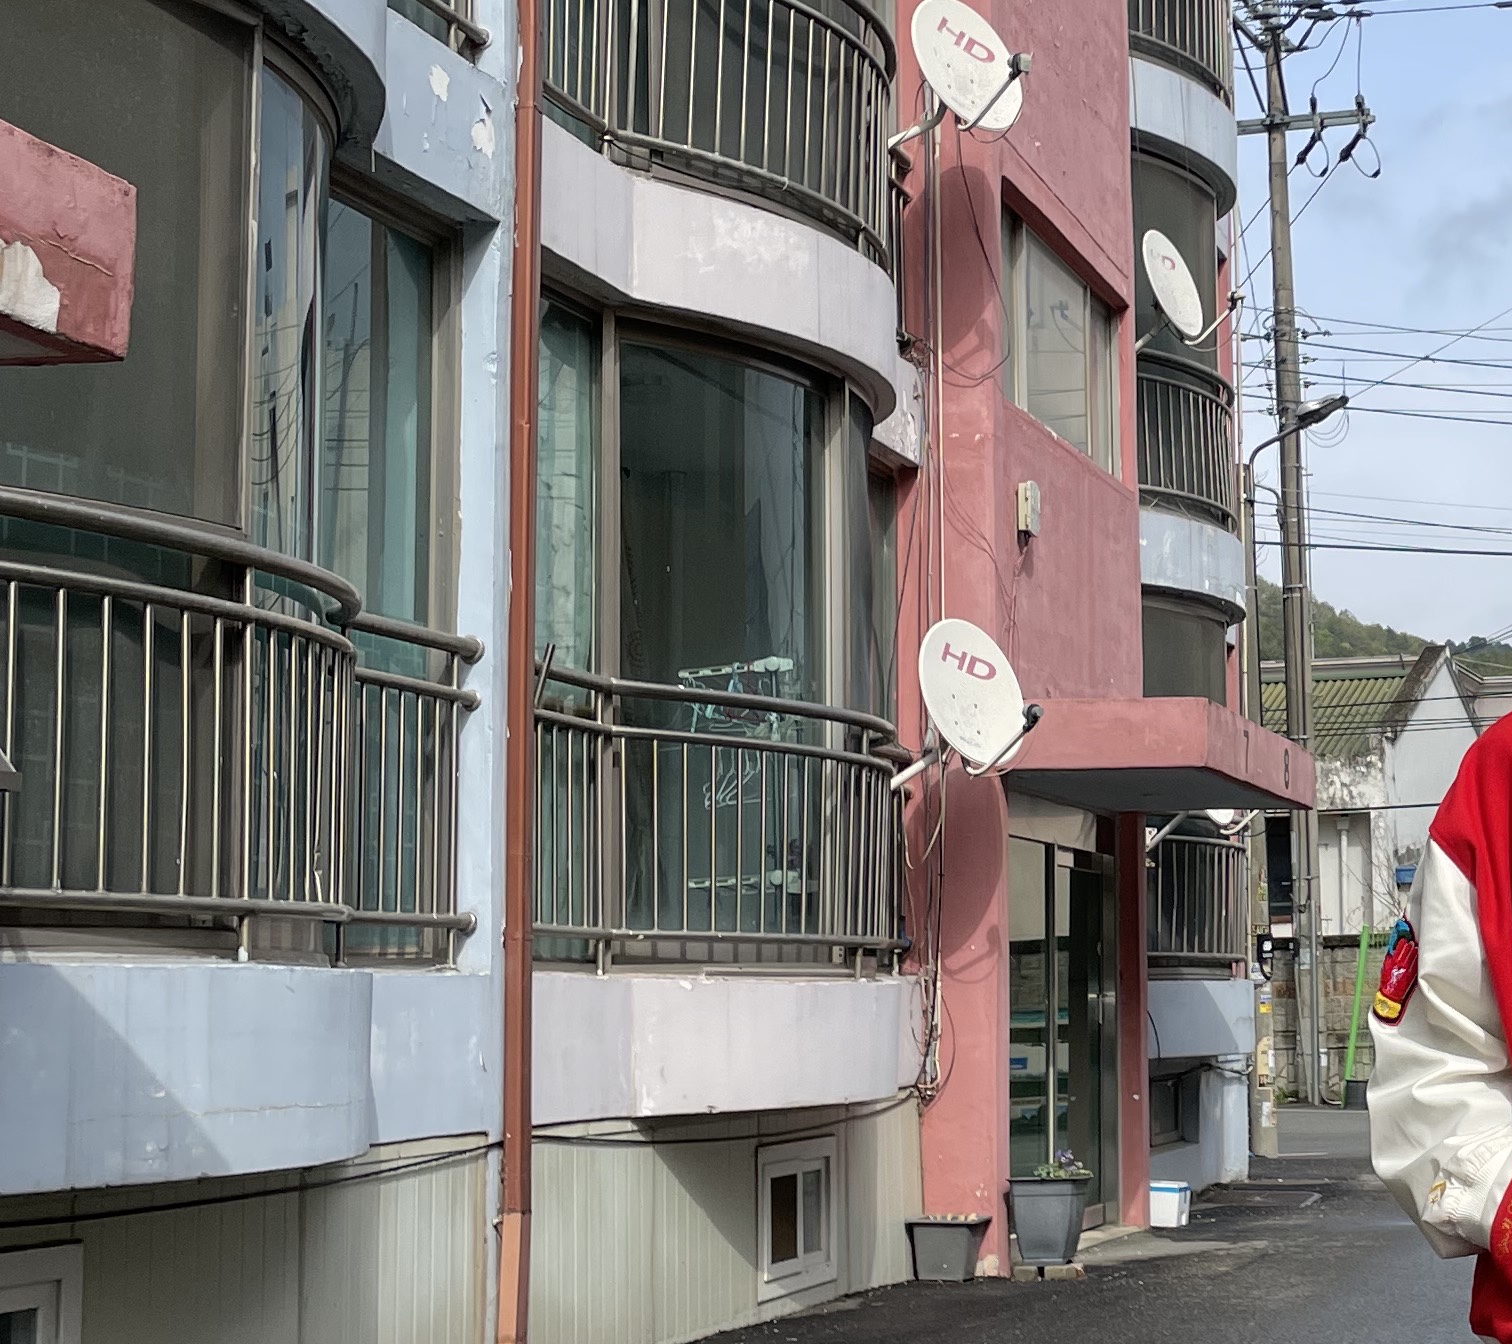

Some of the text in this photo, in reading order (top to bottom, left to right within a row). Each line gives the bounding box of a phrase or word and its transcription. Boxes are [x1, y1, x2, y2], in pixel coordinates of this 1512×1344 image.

[937, 16, 995, 63] HD
[941, 642, 996, 680] HD
[1283, 748, 1290, 790] 8
